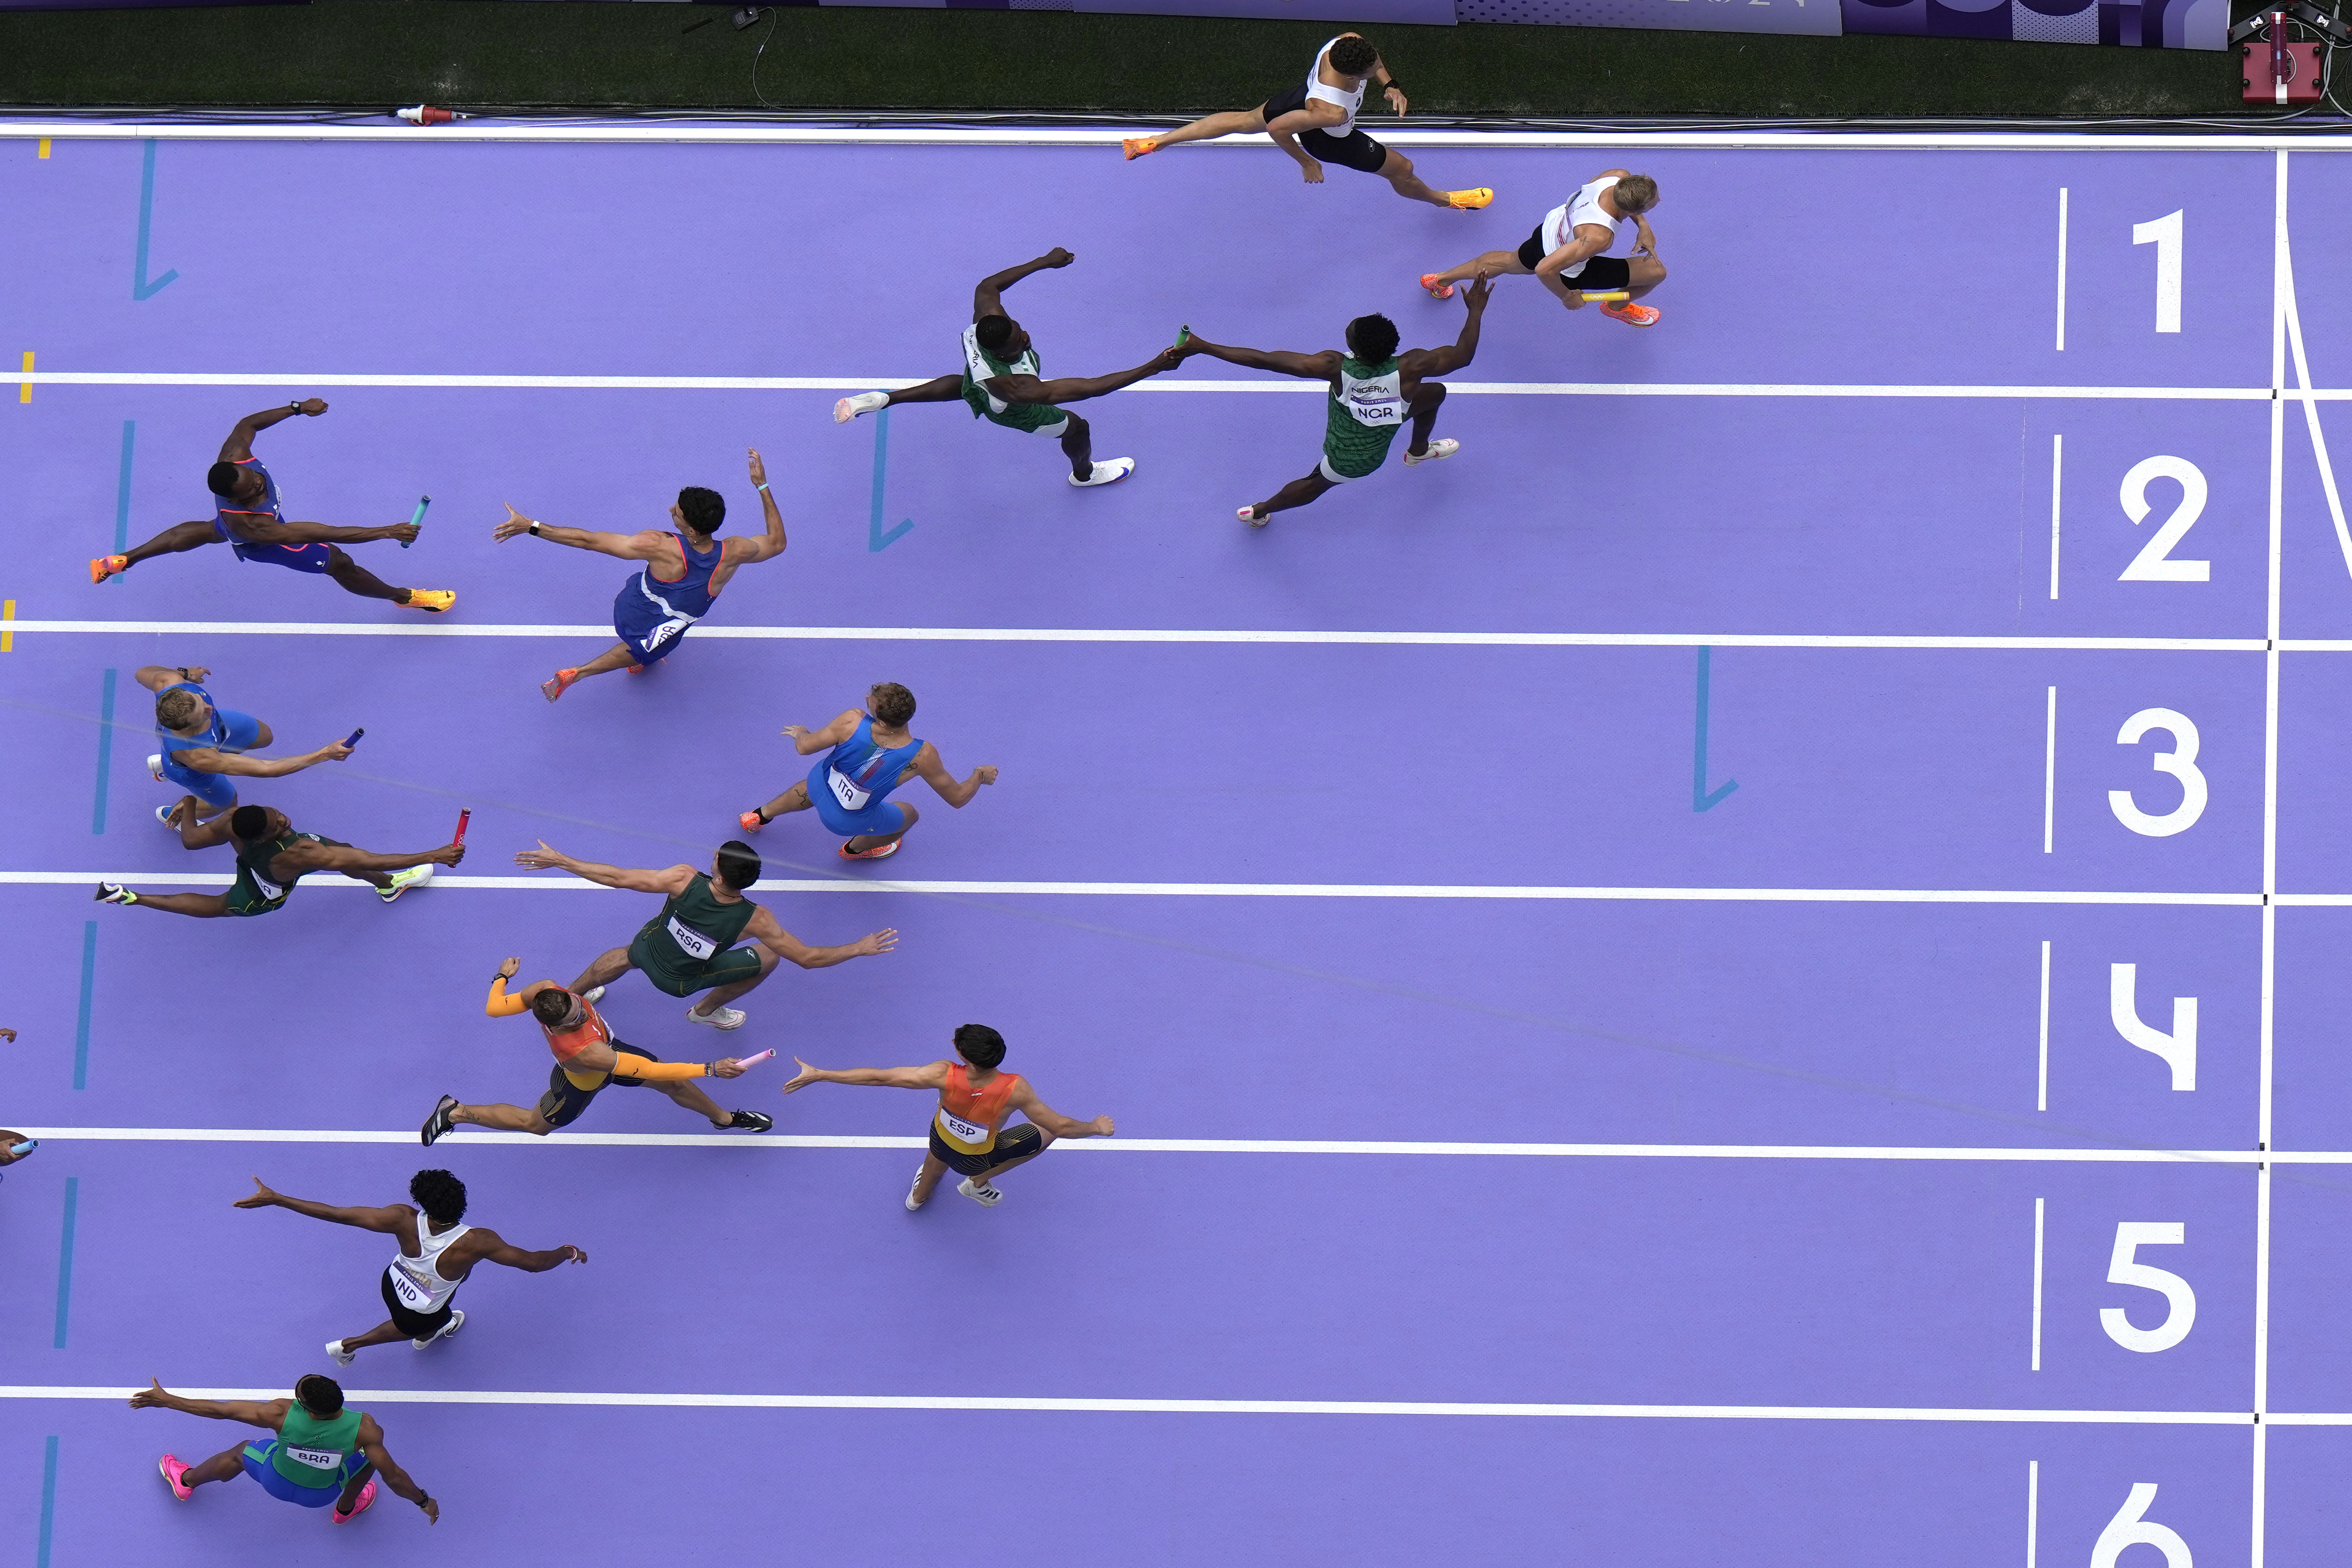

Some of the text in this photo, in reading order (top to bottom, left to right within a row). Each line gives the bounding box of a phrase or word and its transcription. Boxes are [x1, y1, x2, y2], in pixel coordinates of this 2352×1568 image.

[2133, 209, 2183, 332] 1
[1358, 407, 1393, 419] NGR
[2118, 455, 2210, 581] 2
[2109, 708, 2208, 837] 3
[838, 779, 853, 802] ITA
[676, 928, 702, 953] RSA
[2111, 963, 2197, 1091] 4
[949, 1119, 975, 1136] ESP
[395, 1278, 416, 1301] IND
[403, 1270, 414, 1281] PARIS
[413, 1281, 424, 1290] 2024
[2100, 1222, 2195, 1352] 5
[299, 1453, 330, 1463] BRA
[2090, 1483, 2193, 1568] 6
